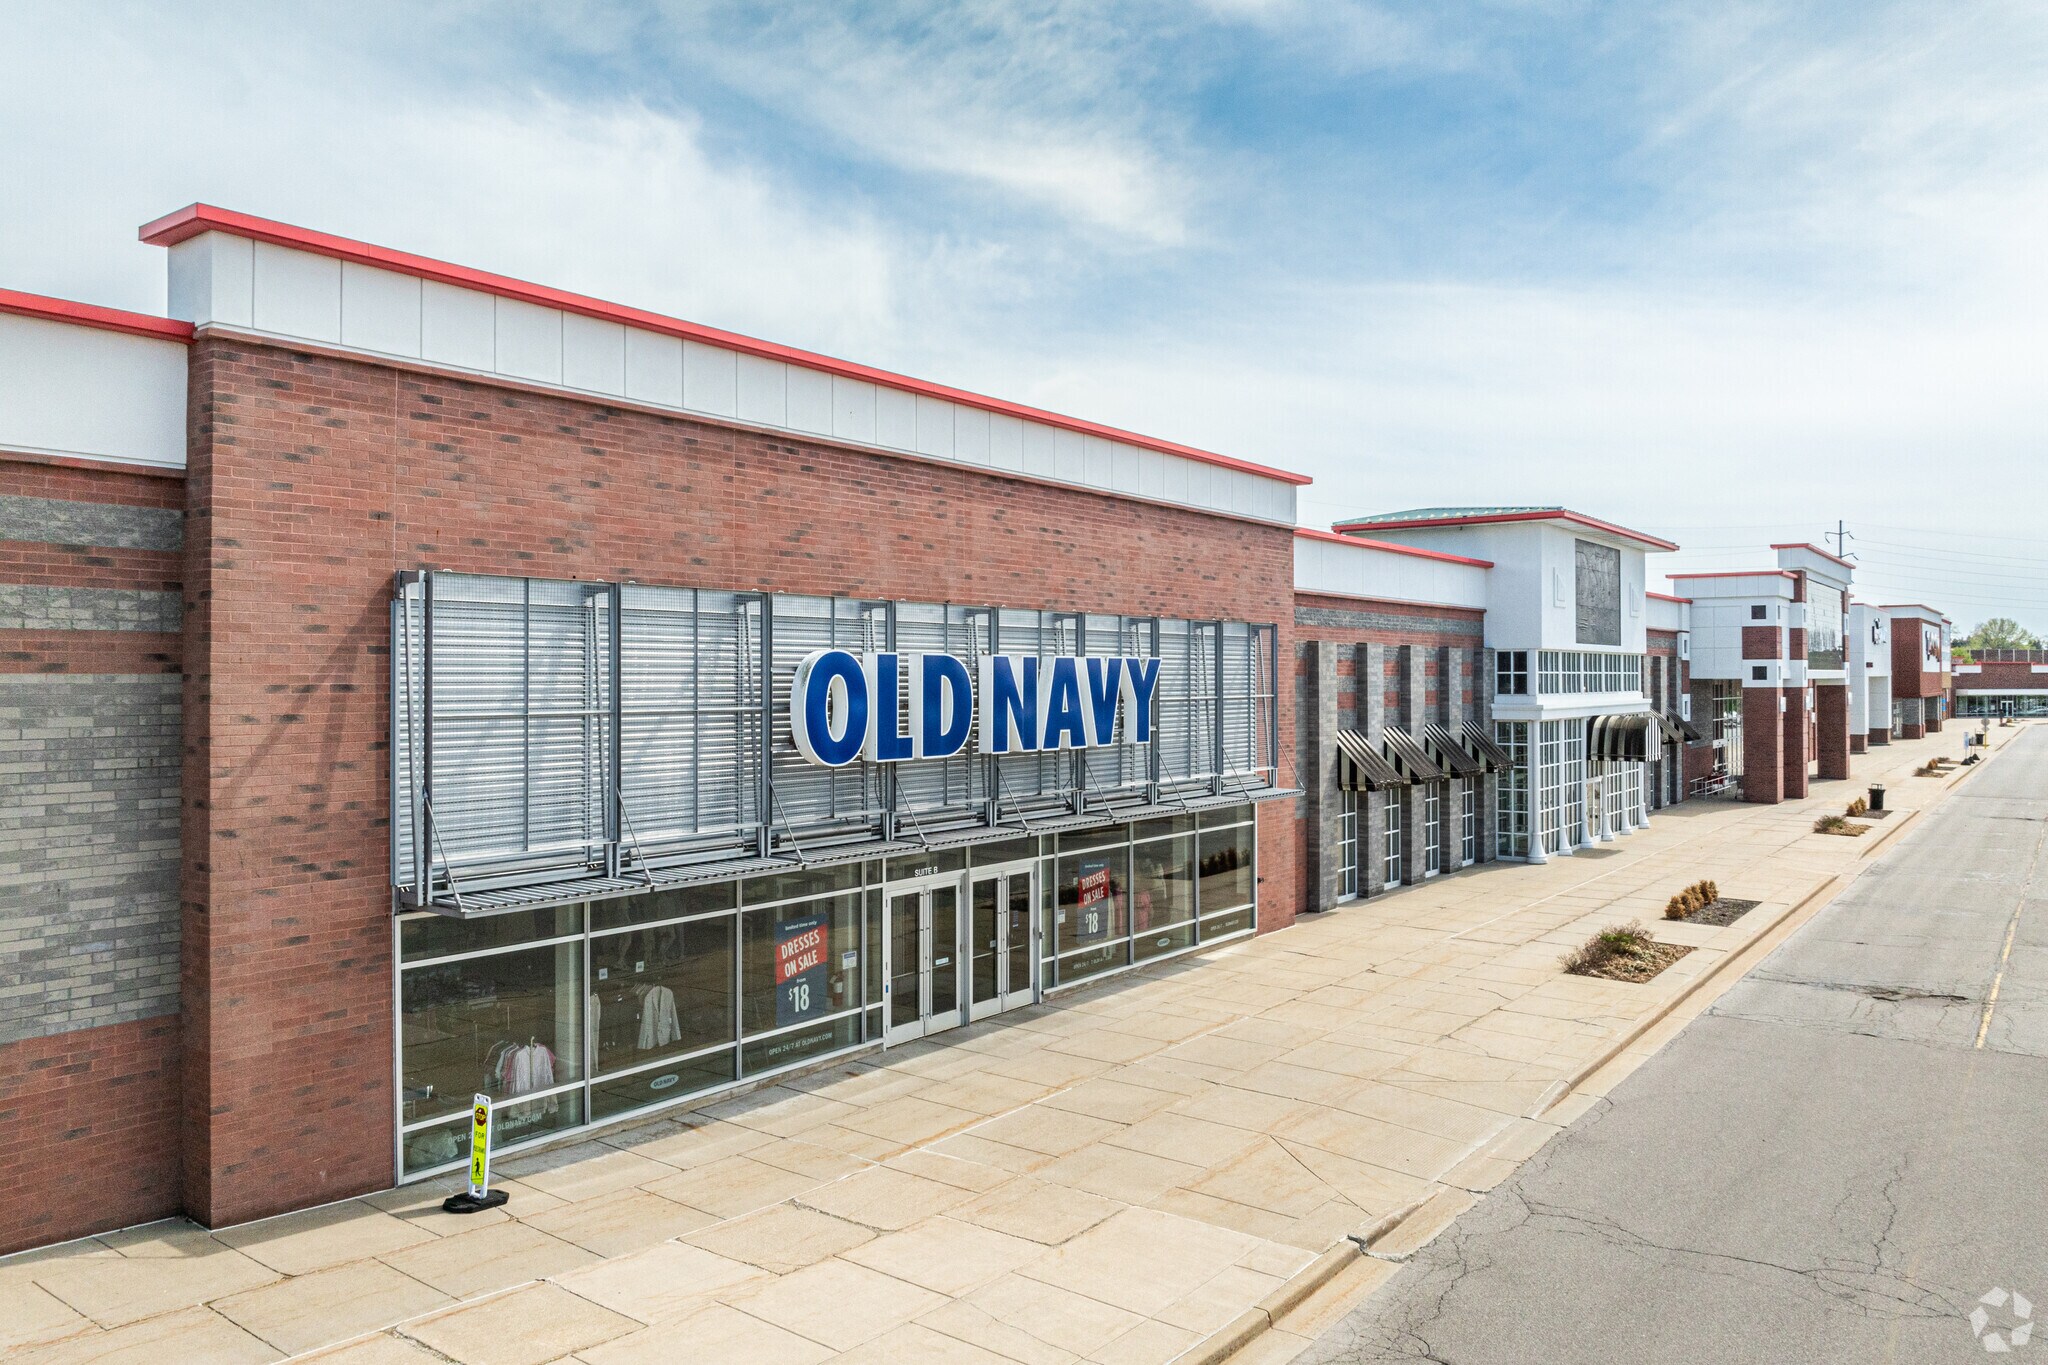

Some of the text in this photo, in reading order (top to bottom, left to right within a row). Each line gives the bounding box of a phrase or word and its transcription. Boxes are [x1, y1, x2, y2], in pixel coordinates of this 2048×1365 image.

[791, 649, 1162, 766] OLD NAVY
[914, 867, 932, 876] SUITE
[1082, 871, 1106, 890] DRESSES
[1084, 887, 1104, 904] ON SALE
[1086, 912, 1098, 934] $18
[782, 929, 820, 960] DRESSES
[784, 950, 818, 978] ON SALE
[788, 984, 809, 1013] $18
[768, 1047, 782, 1056] OPEN
[448, 1134, 466, 1144] OPEN
[496, 1112, 542, 1132] OLDNAVY.COM
[475, 1131, 485, 1139] FOR
